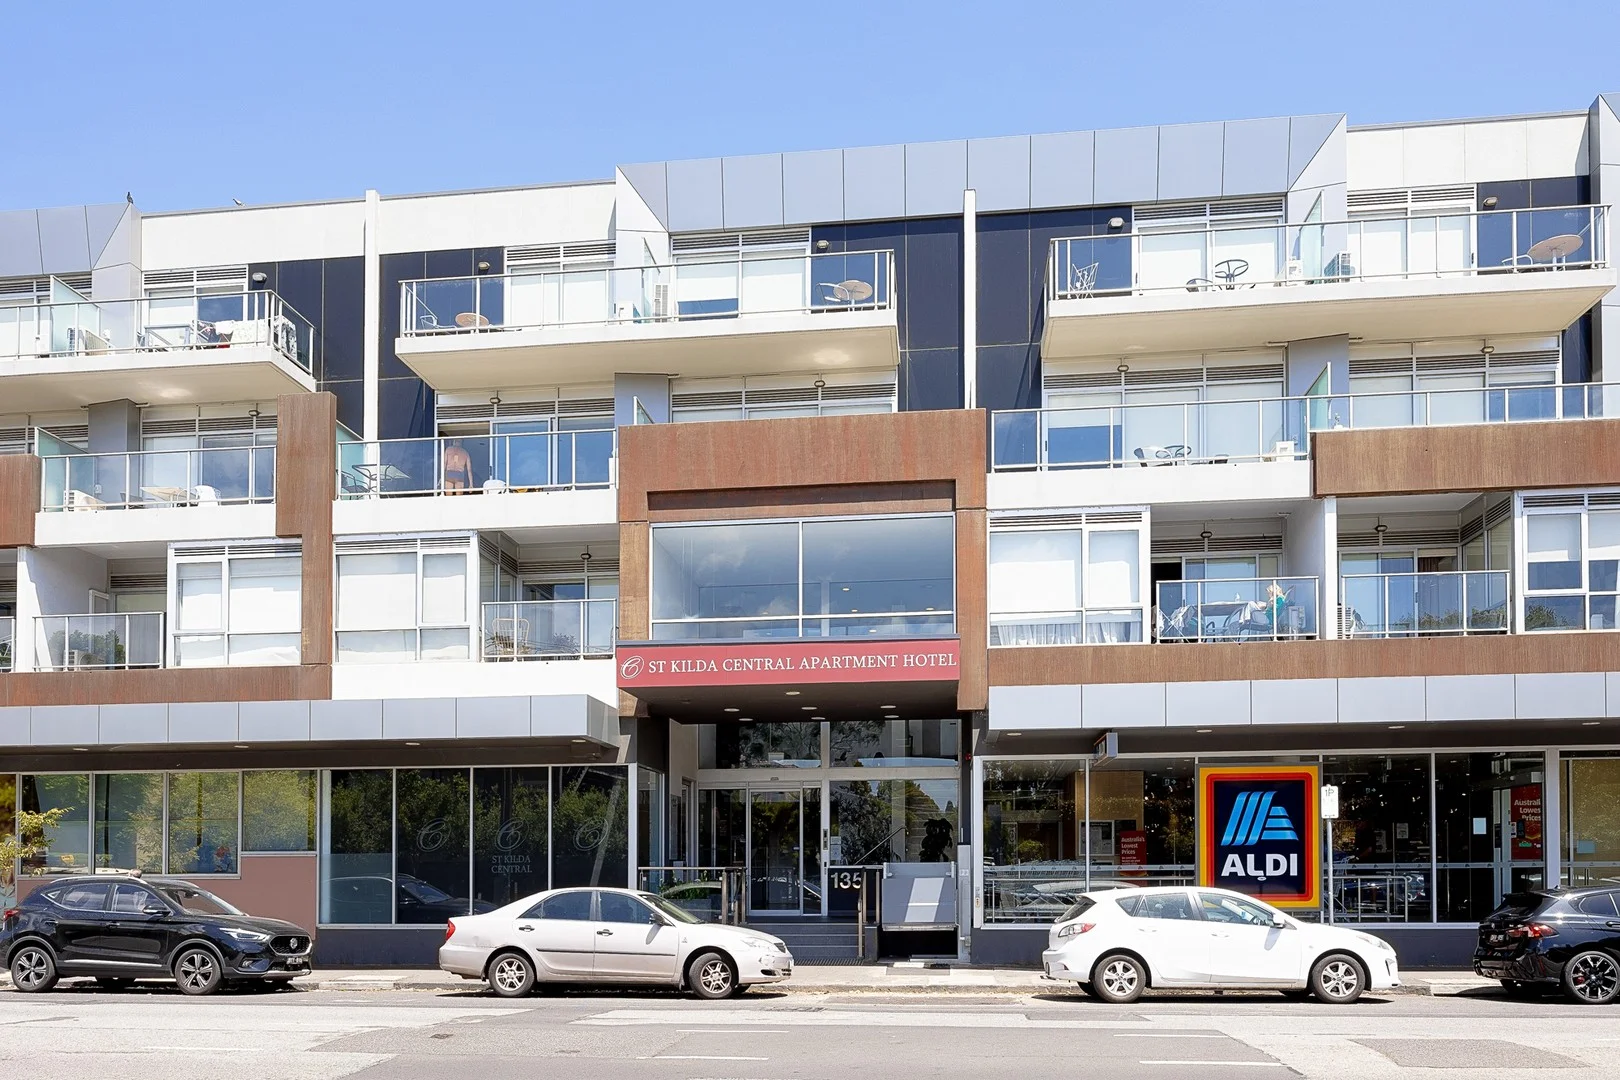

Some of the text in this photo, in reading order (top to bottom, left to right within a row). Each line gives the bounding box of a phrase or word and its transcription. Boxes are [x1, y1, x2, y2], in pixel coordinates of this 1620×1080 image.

[648, 660, 667, 673] ST
[670, 659, 718, 673] KILDA
[722, 658, 795, 672] CENTRAL
[799, 655, 899, 670] APARTMENT
[903, 653, 957, 667] HOTEL
[491, 855, 531, 863] ST KILDA
[1221, 853, 1298, 877] ALDI
[491, 864, 533, 873] CENTRAL
[830, 872, 862, 889] 135
